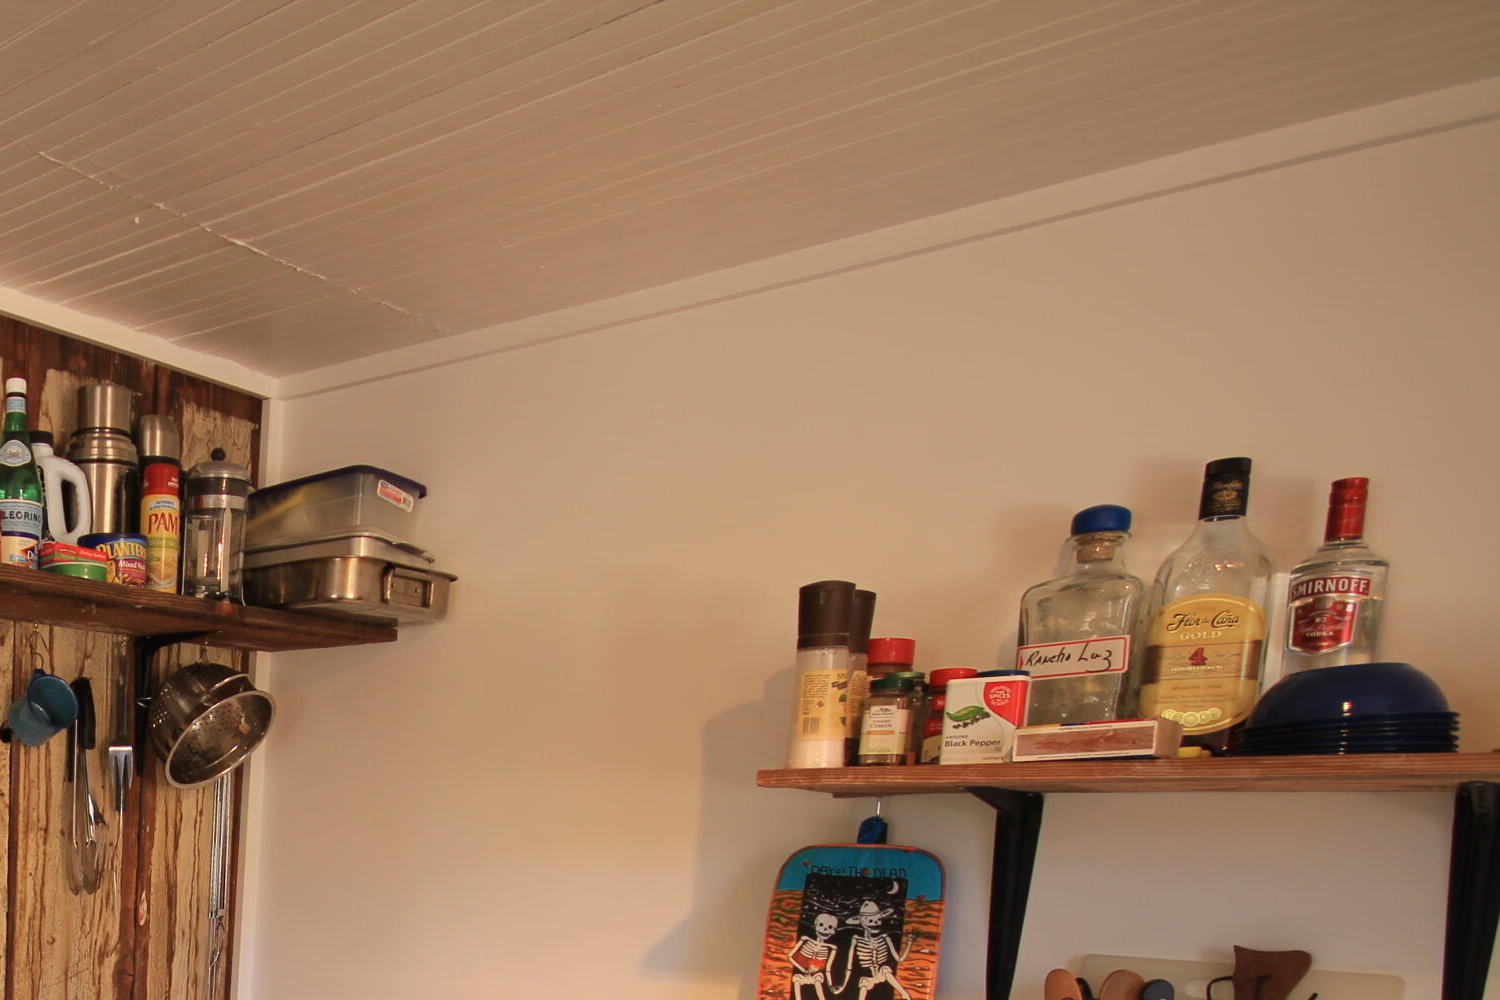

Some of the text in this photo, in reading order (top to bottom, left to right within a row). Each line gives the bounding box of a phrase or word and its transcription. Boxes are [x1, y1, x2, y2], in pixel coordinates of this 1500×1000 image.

[147, 512, 178, 535] PAM
[96, 542, 148, 560] PLANTER
[118, 559, 136, 570] Mixed
[1291, 578, 1366, 599] SMIRNOFF
[1180, 631, 1222, 641] GOLD
[1188, 647, 1208, 666] 4
[945, 738, 1002, 750] Black Pepper
